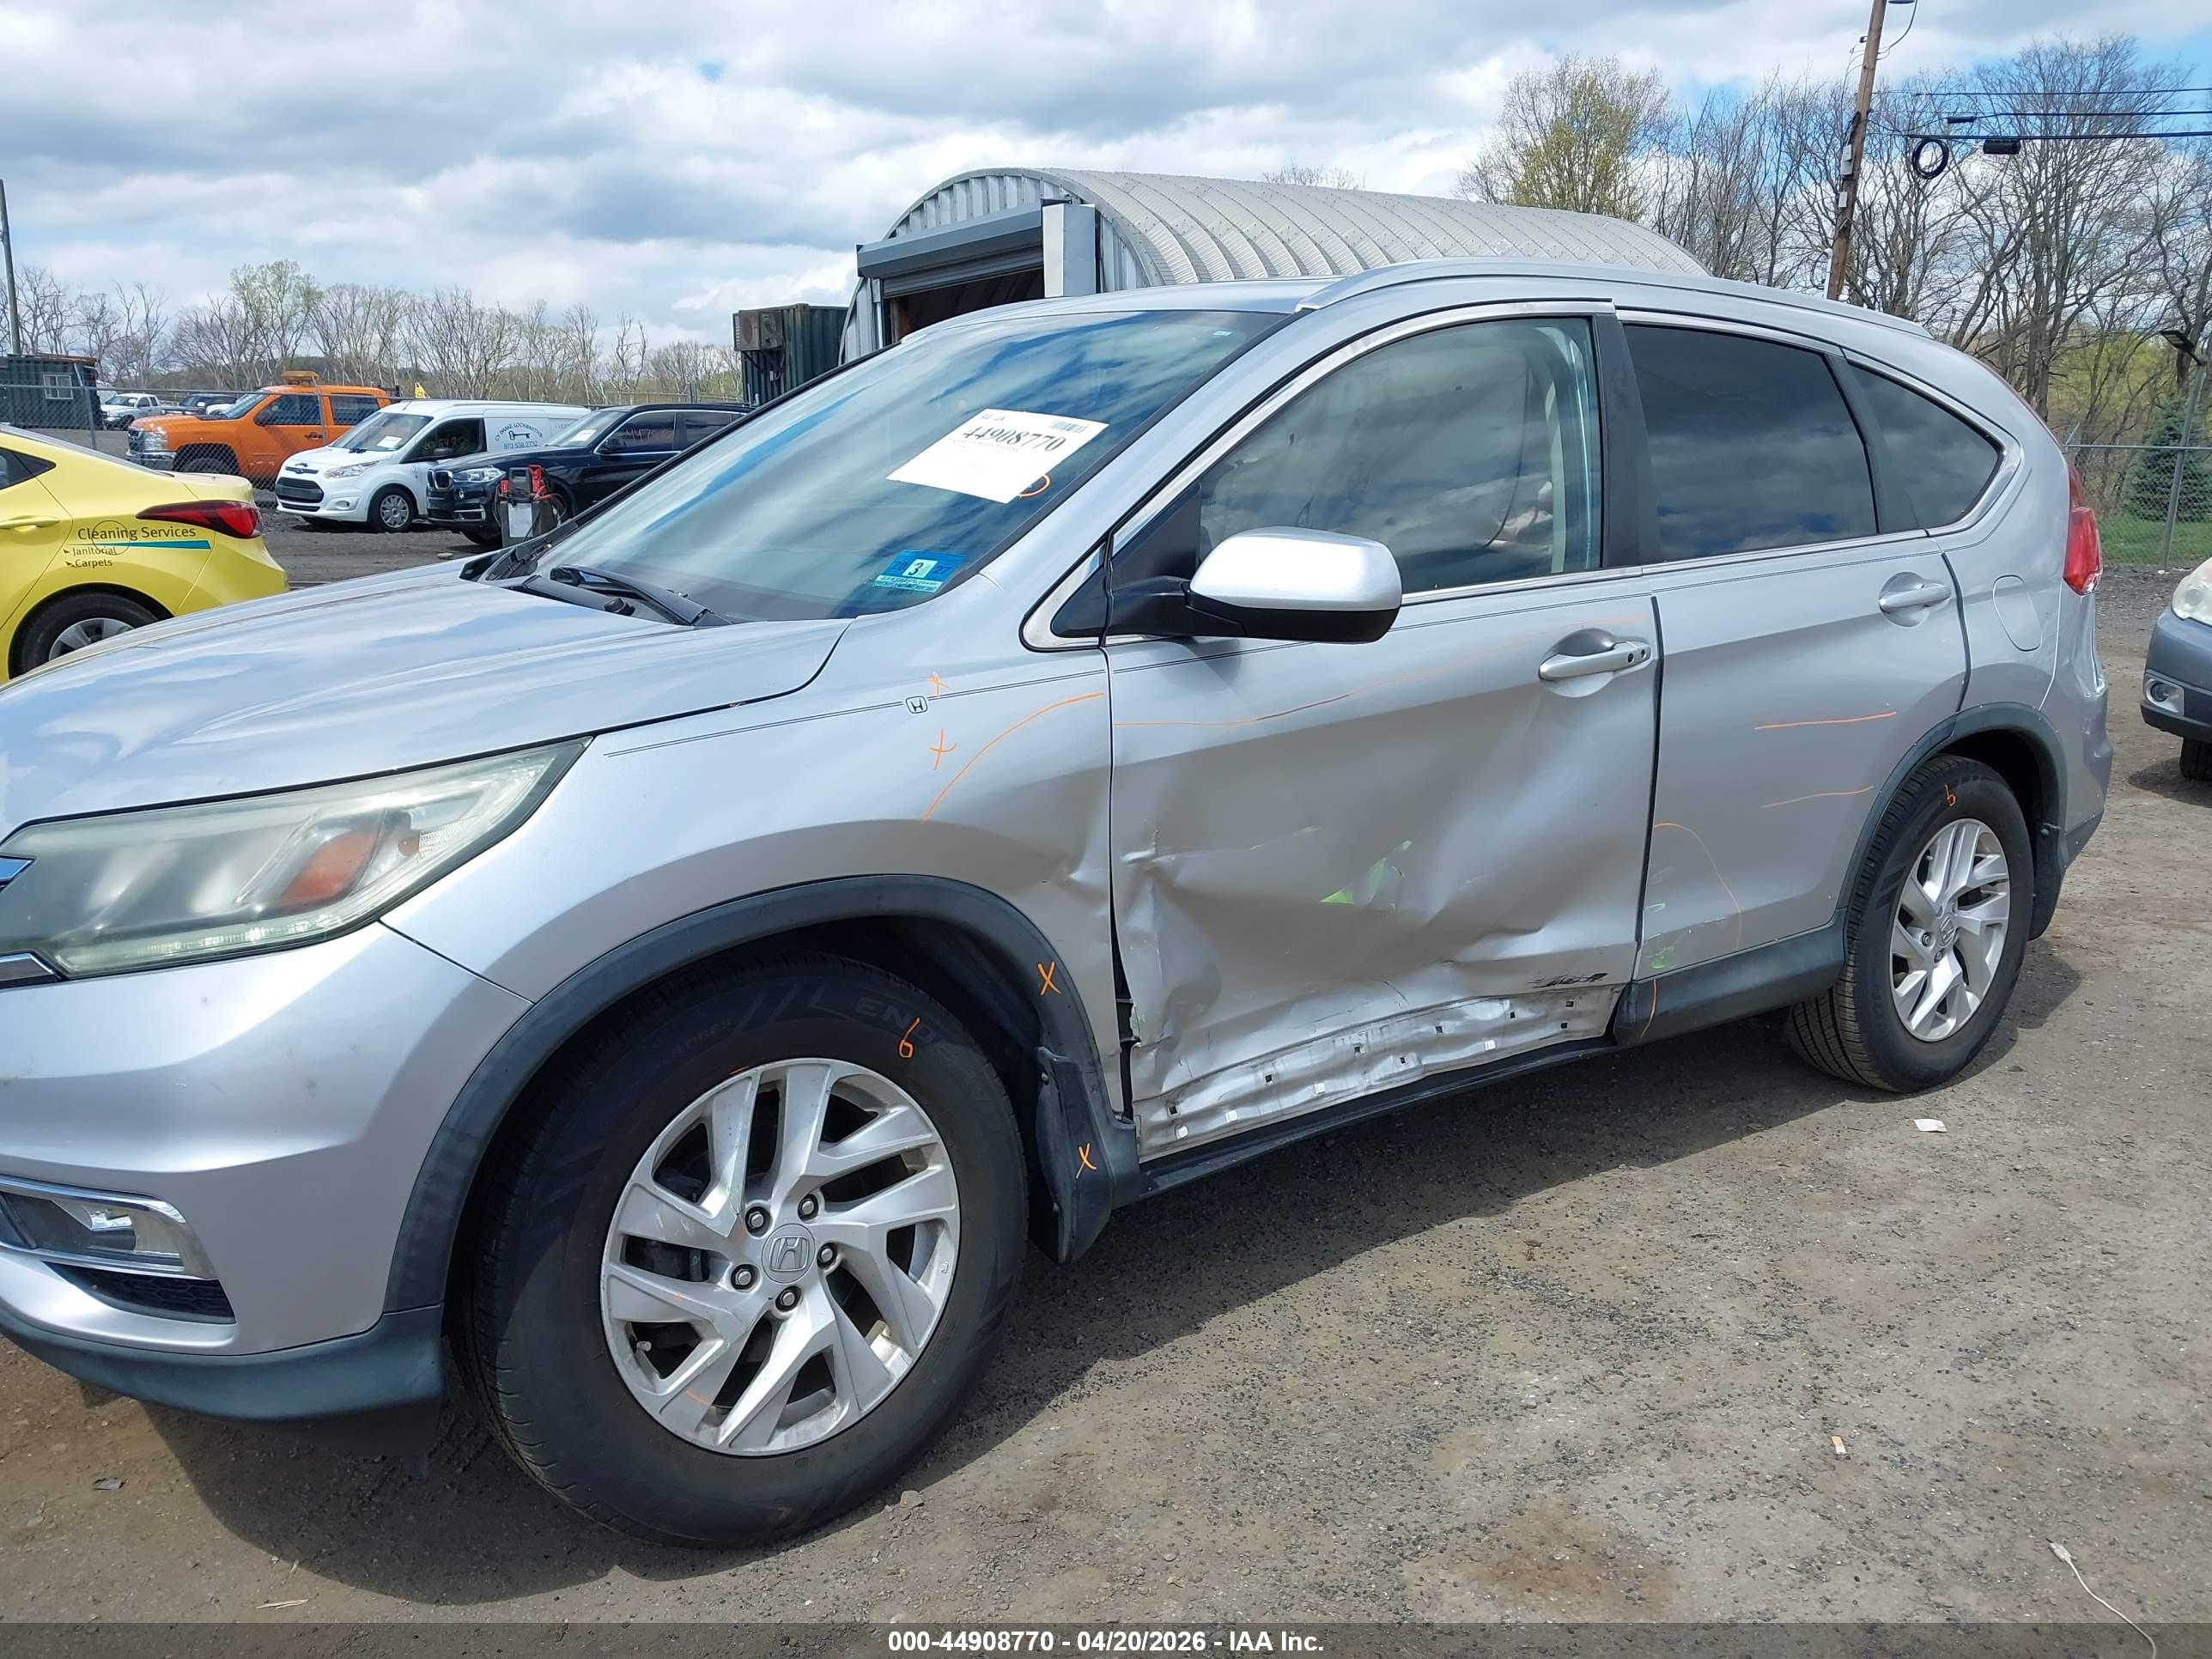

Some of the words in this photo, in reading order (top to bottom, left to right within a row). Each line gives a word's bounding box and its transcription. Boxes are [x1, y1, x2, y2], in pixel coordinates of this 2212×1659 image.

[963, 426, 1066, 452] 44908770
[78, 527, 138, 541] Cleaning
[141, 525, 197, 538] Services
[72, 546, 118, 556] Janitorial
[75, 558, 113, 568] Carpets
[890, 561, 908, 571] 20
[908, 562, 924, 576] 3
[933, 565, 952, 575] 27
[898, 1016, 921, 1059] 6
